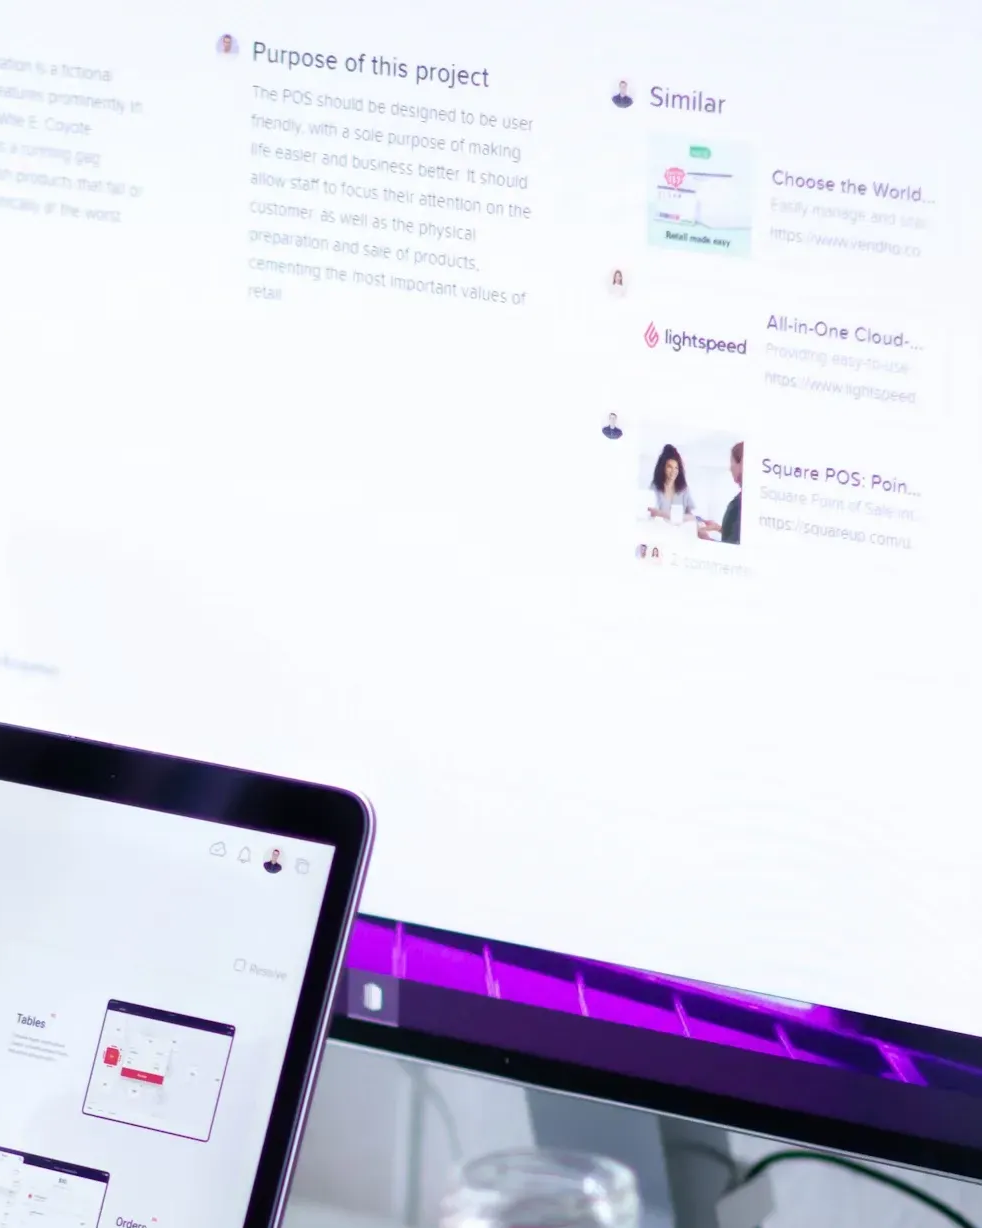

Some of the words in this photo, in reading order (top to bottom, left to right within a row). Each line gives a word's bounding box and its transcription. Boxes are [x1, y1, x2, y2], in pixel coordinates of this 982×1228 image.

[253, 41, 337, 70] Purpose
[345, 53, 366, 72] of
[371, 56, 407, 78] this
[417, 64, 489, 88] project
[47, 92, 126, 115] prominently
[252, 85, 278, 102] The
[282, 89, 312, 105] POS
[316, 94, 363, 111] should
[368, 100, 386, 114] be
[391, 102, 456, 123] designed
[461, 110, 475, 125] to
[480, 113, 497, 127] be
[502, 118, 533, 131] user
[650, 86, 726, 114] Similar
[44, 117, 93, 136] Coyote
[309, 123, 337, 136] with
[342, 127, 349, 139] a
[354, 128, 384, 142] sole
[388, 132, 446, 151] purpose
[451, 138, 465, 152] of
[469, 142, 521, 163] making
[251, 142, 271, 157] life
[275, 147, 317, 163] easier
[321, 153, 347, 167] and
[352, 155, 413, 175] business
[480, 172, 528, 189] should
[249, 172, 286, 188] allow
[290, 177, 320, 191] staff
[323, 180, 337, 195] to
[340, 182, 379, 199] focus
[383, 188, 414, 203] their
[419, 193, 481, 213] attention
[486, 203, 504, 215] on
[509, 204, 532, 219] the
[772, 169, 835, 191] Choose
[841, 178, 867, 195] the
[320, 210, 336, 223] as
[340, 213, 367, 227] well
[372, 217, 387, 229] as
[392, 218, 414, 233] the
[419, 222, 476, 241] physical
[248, 230, 329, 250] preparation
[332, 240, 359, 255] and
[363, 244, 391, 259] sale
[396, 247, 410, 261] of
[248, 257, 321, 281] cementing
[325, 267, 347, 282] the
[353, 269, 386, 287] most
[391, 276, 457, 297] important
[461, 286, 507, 303] values
[512, 291, 528, 305] of
[665, 328, 747, 355] lightspeed
[767, 314, 849, 340] All-in-One
[762, 457, 820, 481] Square
[825, 467, 866, 488] POS:
[16, 1012, 47, 1029] Tables
